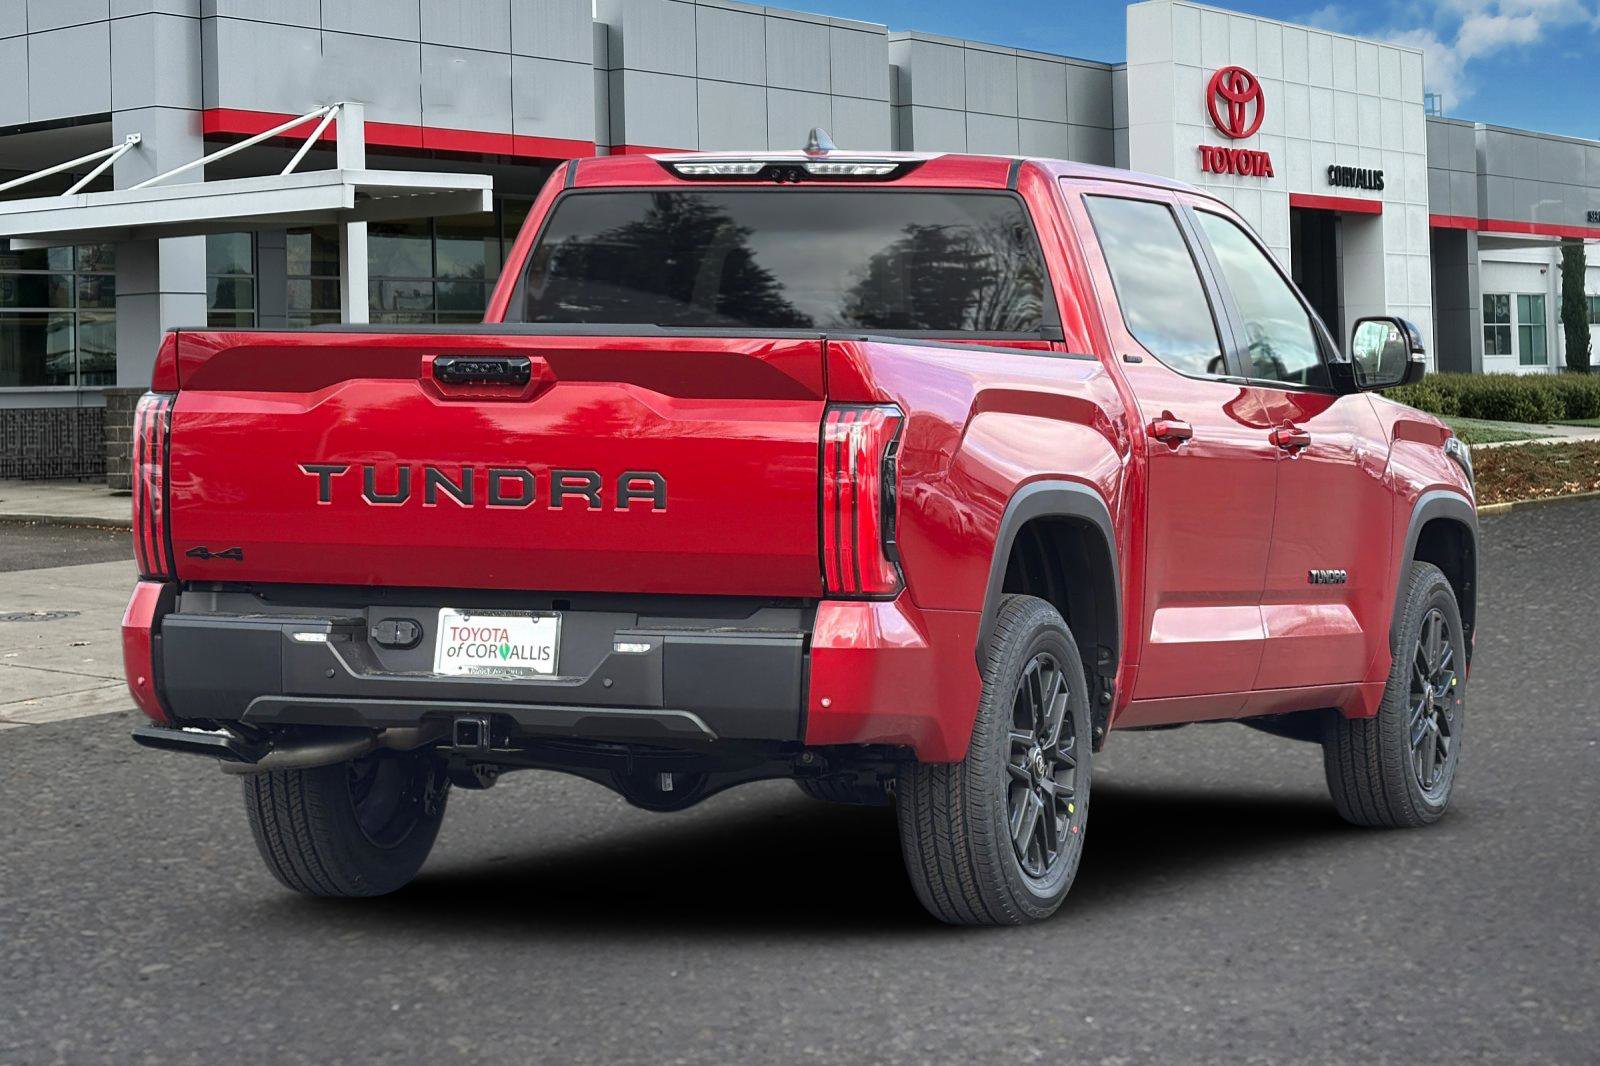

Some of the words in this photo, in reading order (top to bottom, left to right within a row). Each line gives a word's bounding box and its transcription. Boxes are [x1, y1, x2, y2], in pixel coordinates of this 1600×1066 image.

[1198, 145, 1274, 178] TOYOTA
[1327, 164, 1385, 191] CORVALLIS
[298, 463, 667, 512] TUNDRA
[1308, 569, 1347, 584] TUNDRA
[450, 626, 510, 643] TOYOTA
[446, 642, 464, 658] of
[465, 642, 551, 661] CORVALLIS
